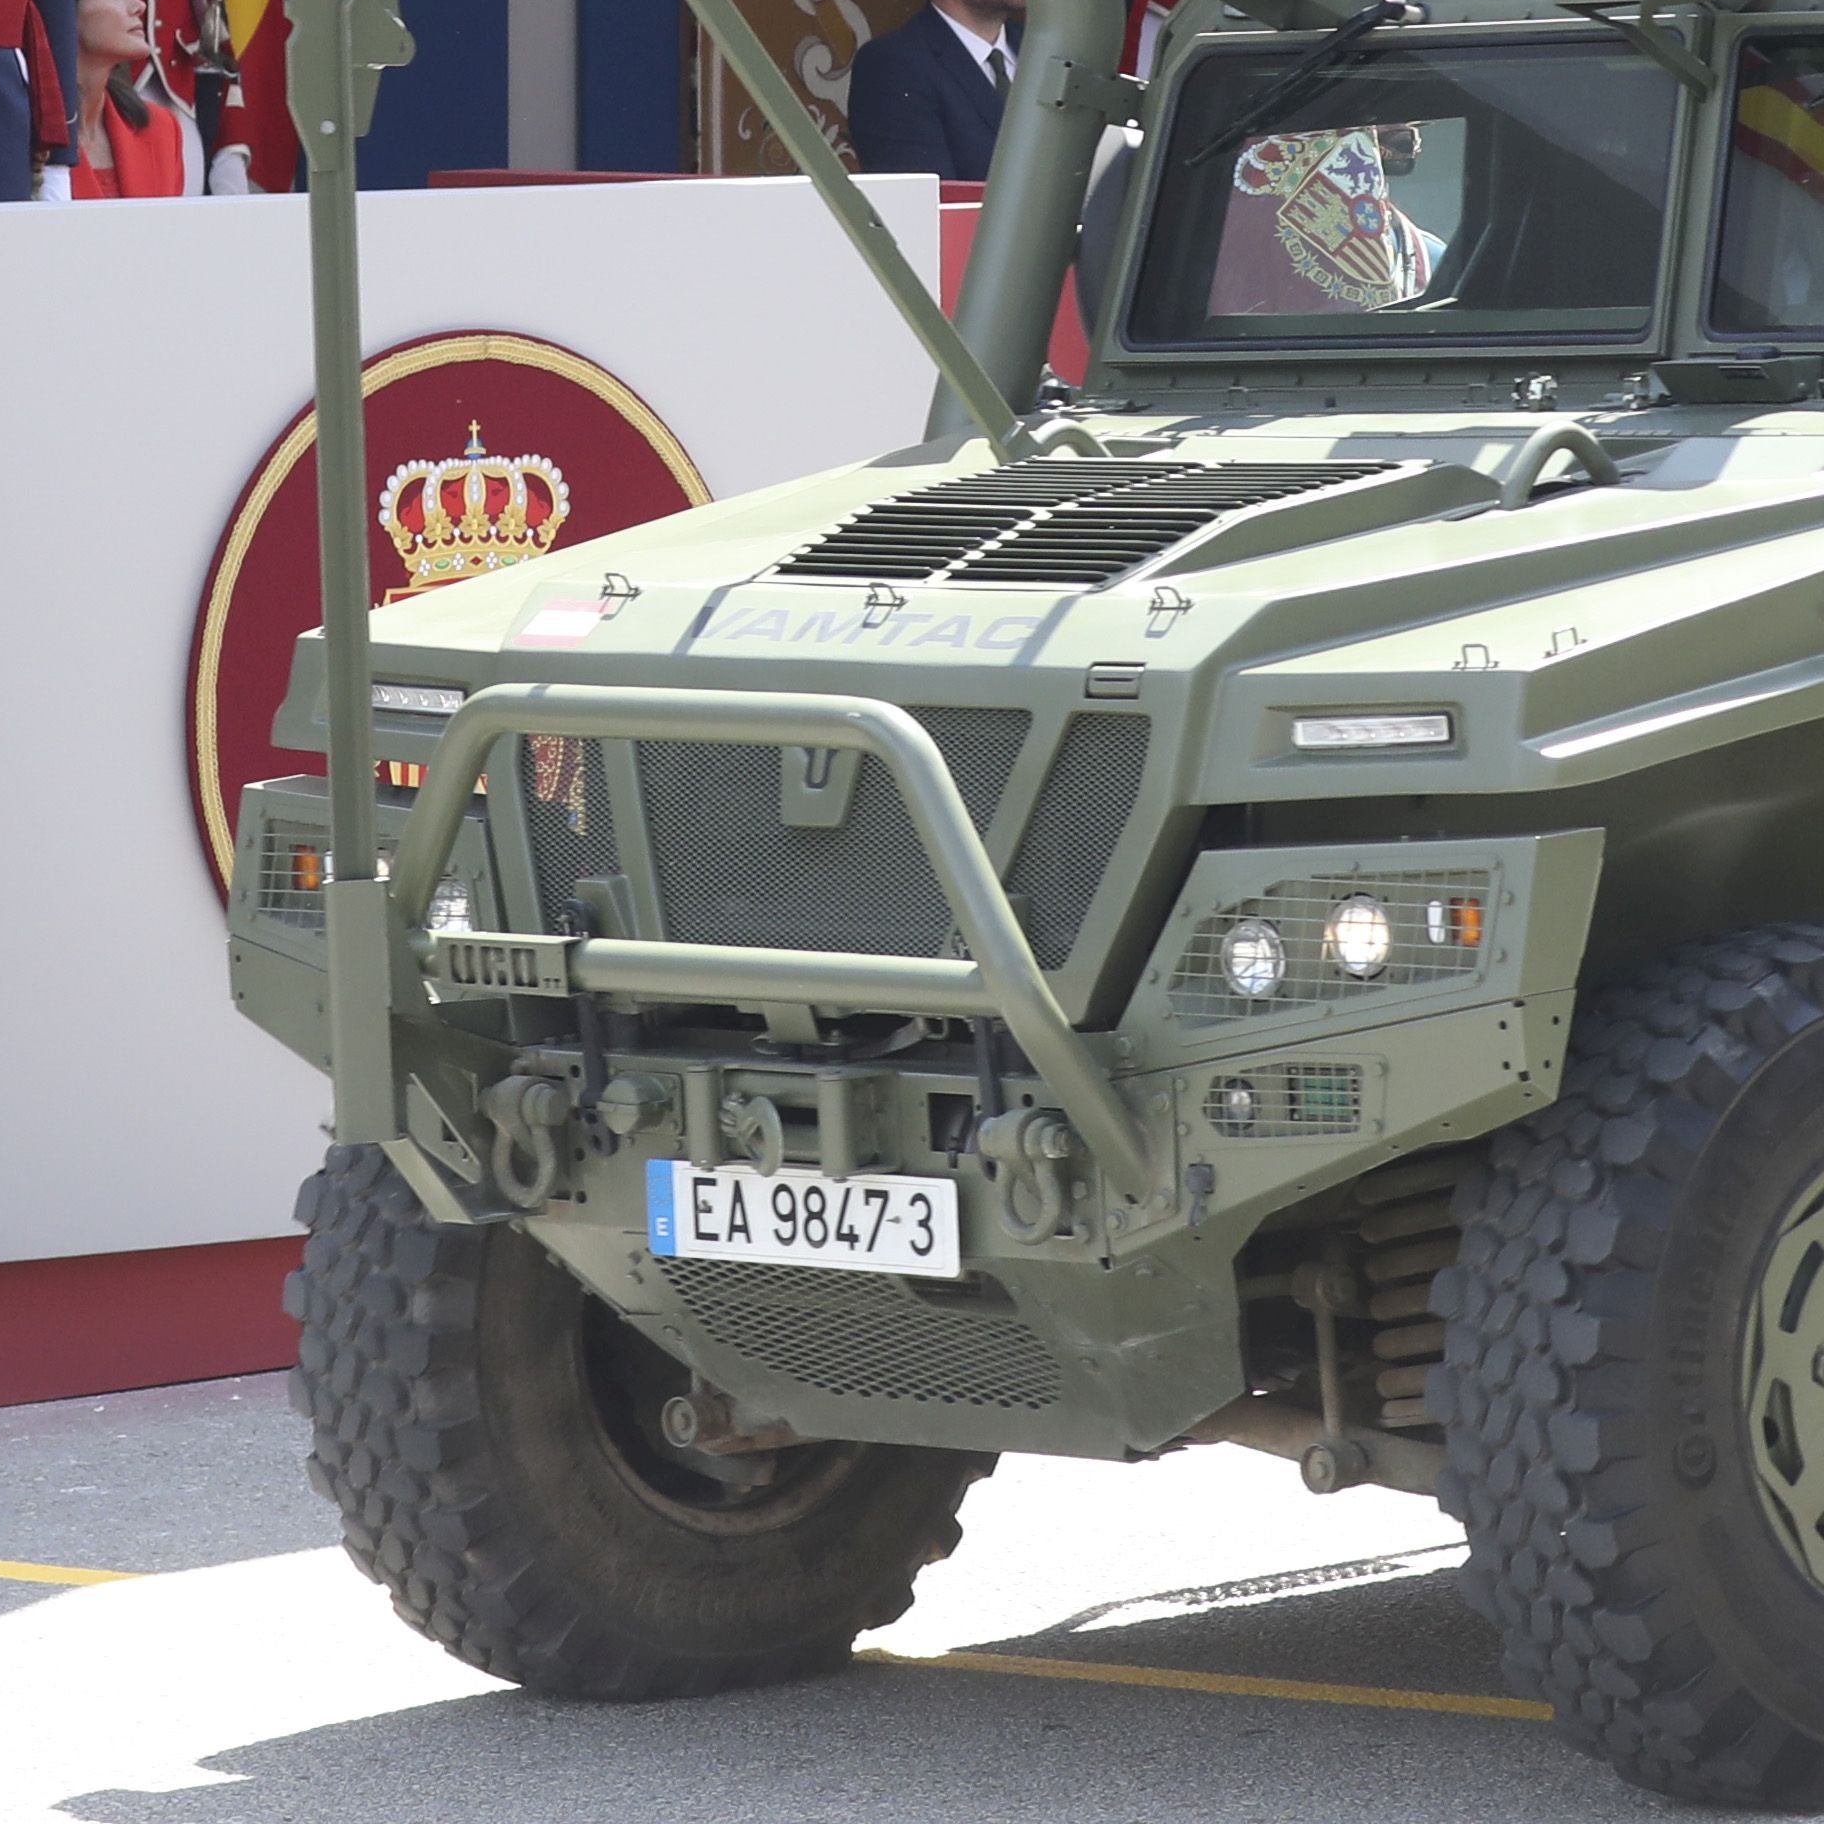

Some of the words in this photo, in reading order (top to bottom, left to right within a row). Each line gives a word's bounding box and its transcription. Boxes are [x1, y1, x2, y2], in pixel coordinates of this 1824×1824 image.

[693, 605, 1046, 650] VAMTAC
[656, 1217, 669, 1236] E
[693, 1177, 751, 1244] EA
